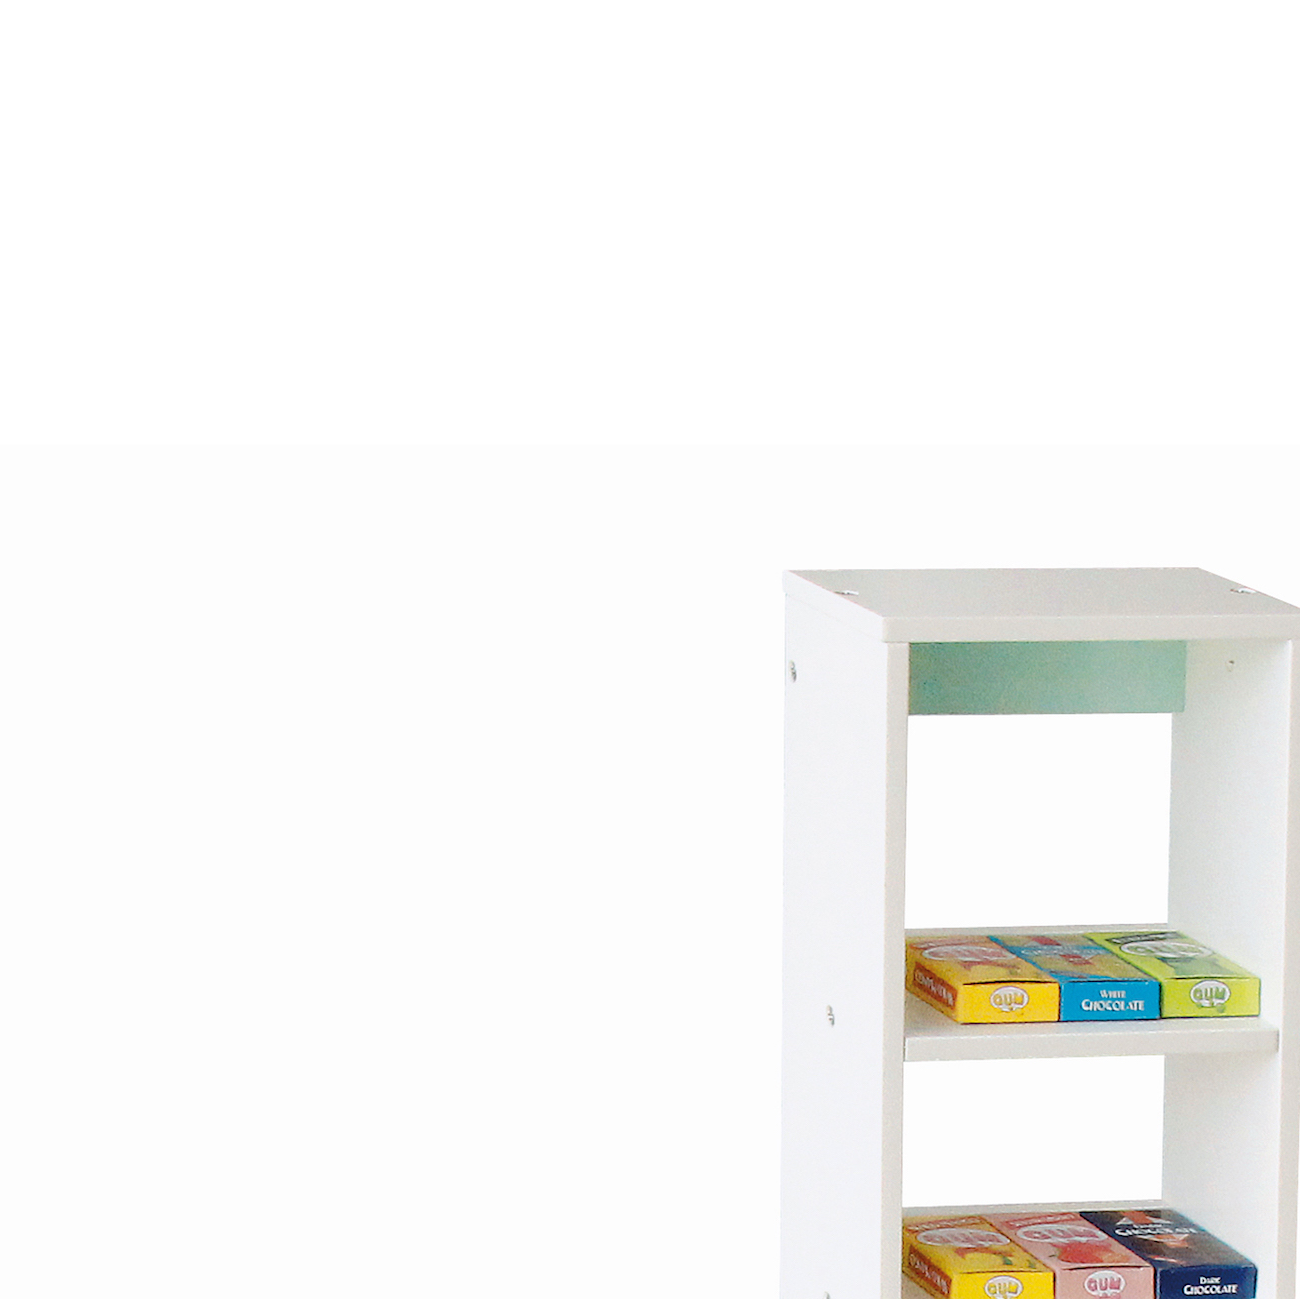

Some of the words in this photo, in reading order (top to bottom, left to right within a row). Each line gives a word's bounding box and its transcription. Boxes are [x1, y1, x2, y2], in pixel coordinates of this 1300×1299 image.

[1081, 999, 1145, 1012] CHOCOLATE
[1087, 1277, 1123, 1292] GUM
[1200, 1276, 1221, 1284] DARK
[1183, 1284, 1239, 1295] CHOCOLATE
